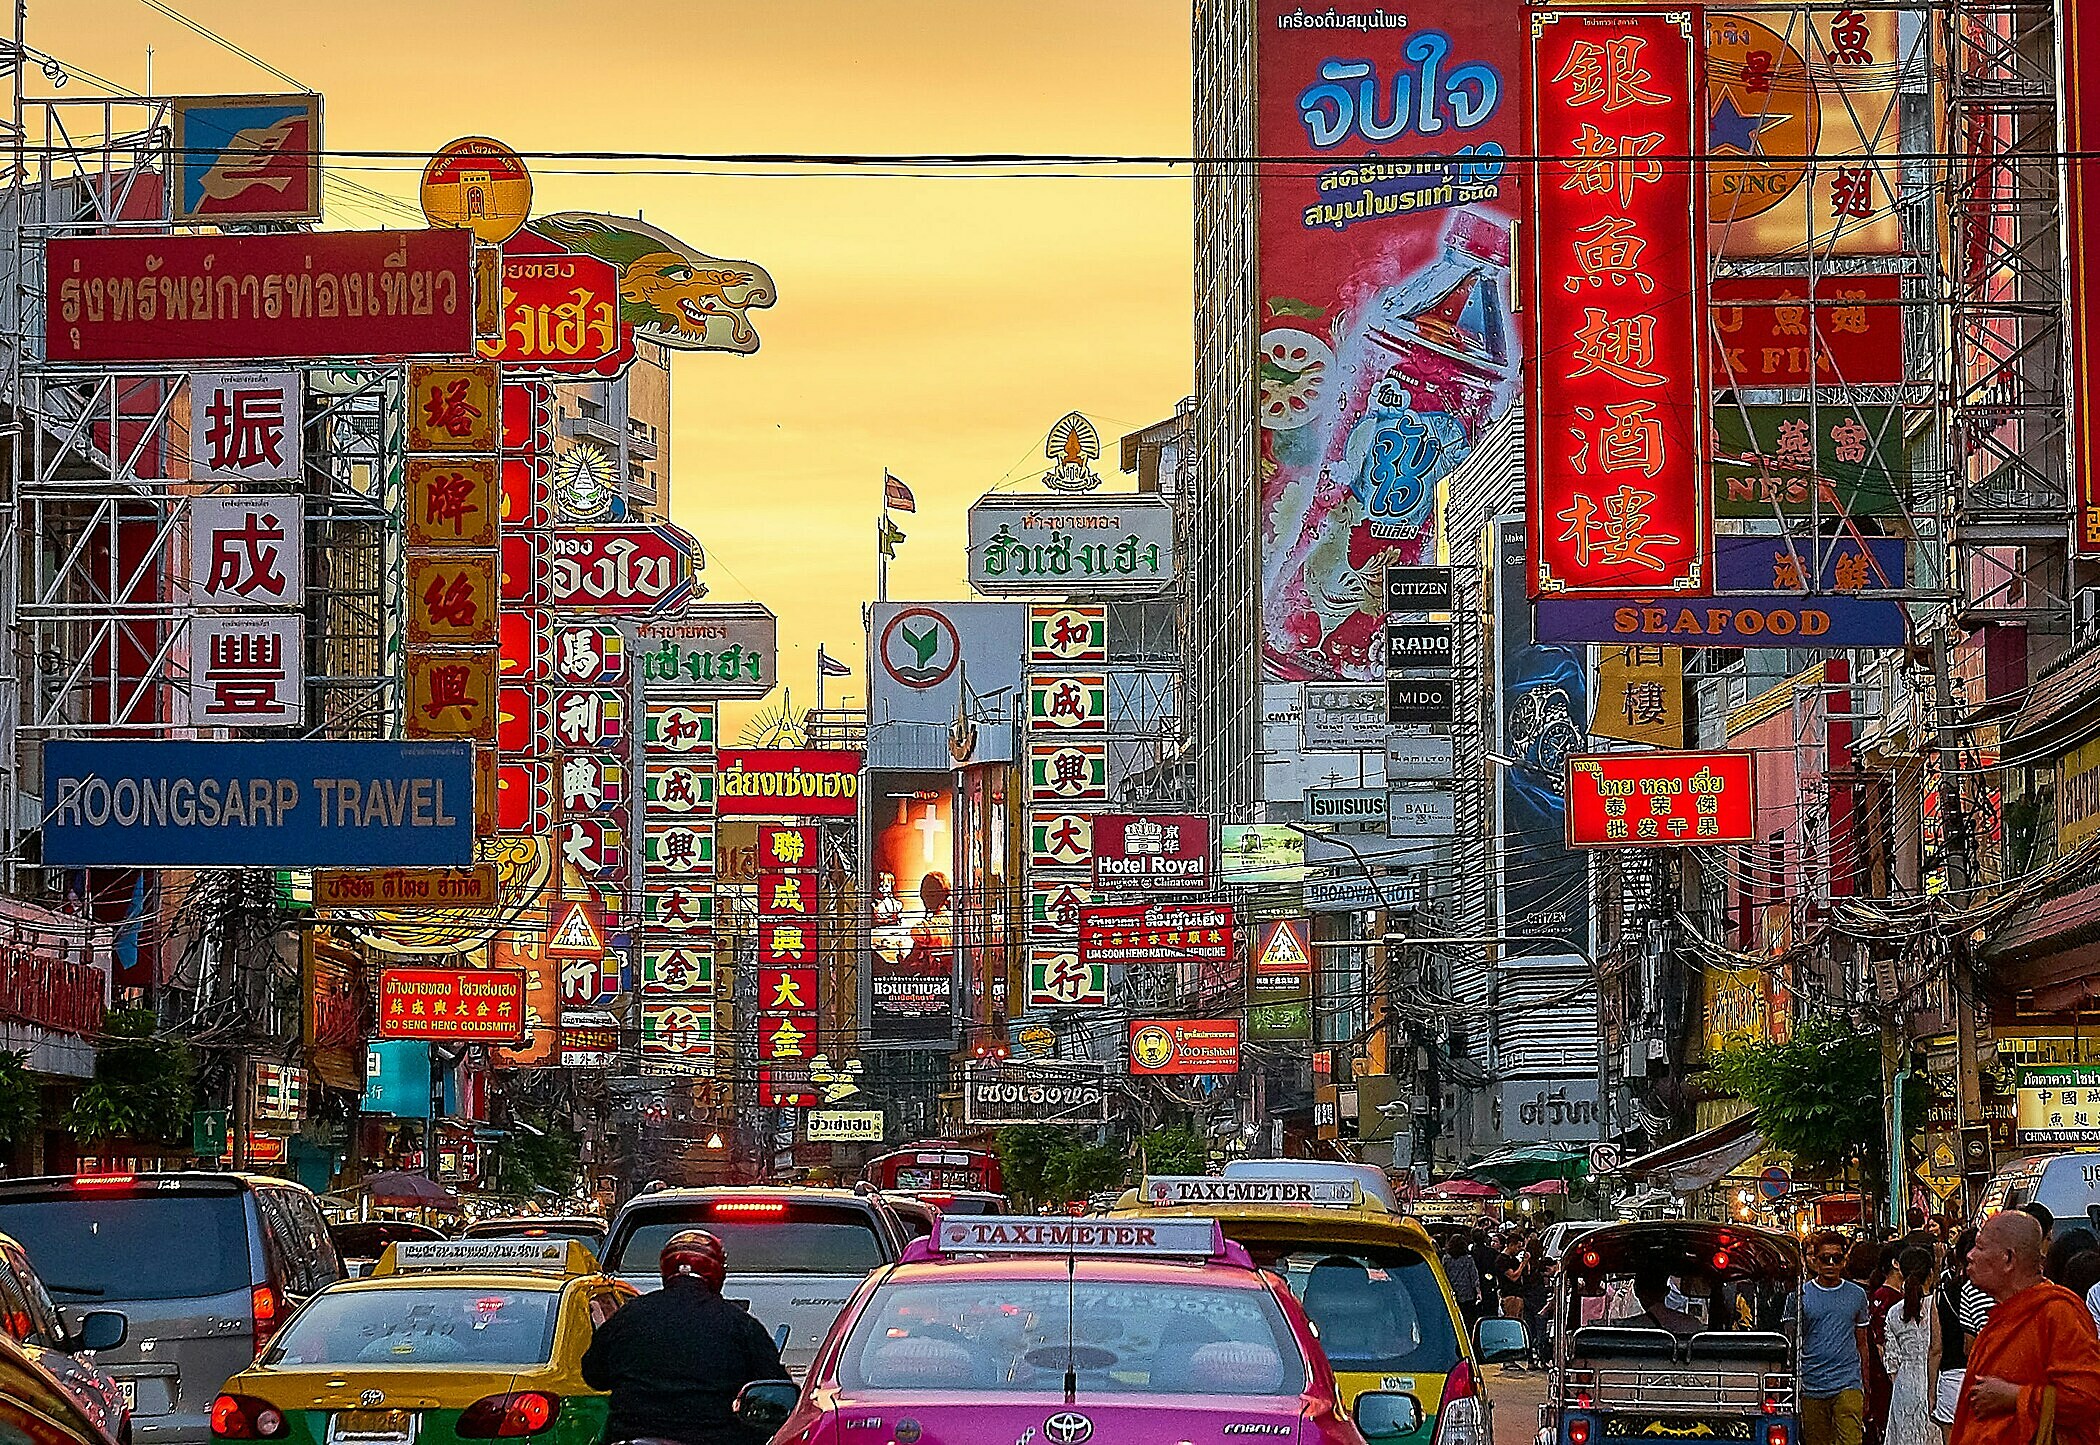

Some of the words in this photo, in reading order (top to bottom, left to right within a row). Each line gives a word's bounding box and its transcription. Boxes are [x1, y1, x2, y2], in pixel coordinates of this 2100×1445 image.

[1277, 6, 1408, 32] เครื่องดื่มสมุนไพร
[1300, 33, 1498, 146] จับใจ
[1452, 142, 1504, 185] 10
[1722, 174, 1788, 195] SING
[60, 234, 457, 350] รุ่งทรัพย์การท่องเที่ยว
[1551, 34, 1680, 573] 銀都魚翅酒樓
[1761, 346, 1831, 374] FIN
[1021, 510, 1121, 531] ห้างขายทอง
[1390, 582, 1449, 596] CITIZEN
[1613, 608, 1832, 636] SEAFOOD
[1391, 637, 1450, 651] RADO
[1398, 691, 1443, 704] MIDO
[717, 757, 857, 799] เลี่ยงเซ่งเฮง
[1593, 770, 1633, 796] ไทย
[1639, 777, 1681, 796] หลง
[56, 777, 300, 828] ROONGSARP
[312, 777, 456, 828] TRAVEL
[1309, 792, 1388, 816] โรงแรมบร
[1405, 803, 1439, 814] BALL
[1098, 856, 1146, 874] Hotel
[1151, 856, 1205, 876] Royal
[1154, 877, 1205, 887] Chinatown
[1102, 948, 1125, 959] SOON
[1126, 948, 1149, 959] HENG
[385, 977, 452, 997] ห้างขายทอง
[385, 1020, 399, 1030] SO
[401, 1020, 428, 1031] SENG
[430, 1020, 458, 1032] HENG
[459, 1020, 517, 1033] GOLDSMITH
[1201, 1046, 1236, 1057] Fishball
[2048, 1111, 2100, 1128] 魚翅
[2024, 1131, 2052, 1142] CHINA
[2053, 1131, 2080, 1142] TOWN
[1176, 1182, 1315, 1202] TAXI-METER
[971, 1222, 1158, 1246] TAXI-METER
[1223, 1423, 1291, 1437] COROLLA
